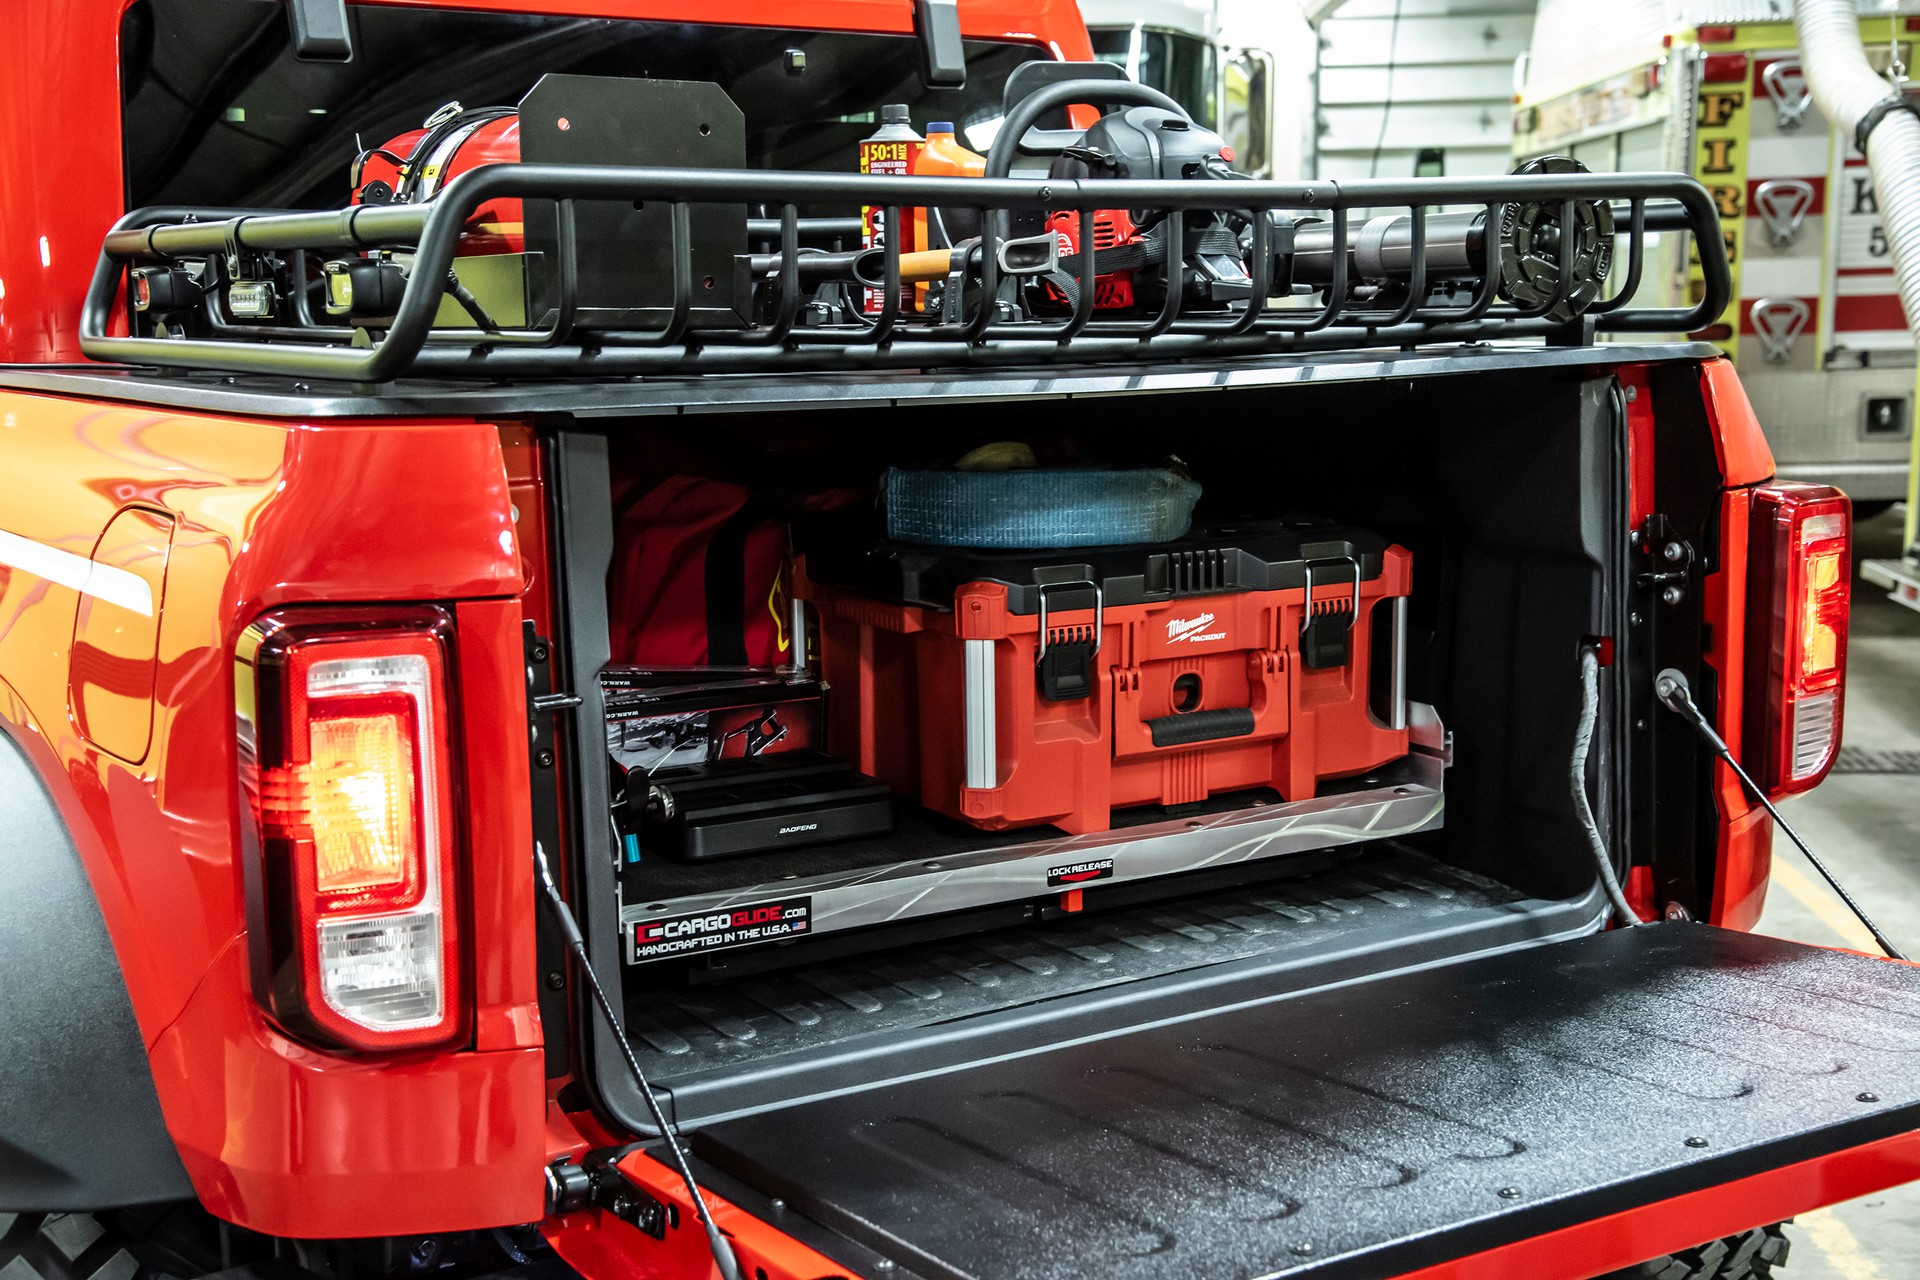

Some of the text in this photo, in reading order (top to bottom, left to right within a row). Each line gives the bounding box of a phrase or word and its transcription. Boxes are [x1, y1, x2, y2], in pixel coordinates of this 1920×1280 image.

[870, 144, 897, 161] 50:1
[898, 143, 907, 160] MIX
[1165, 612, 1215, 638] Milwaukee
[1190, 632, 1227, 642] PACKOUT
[779, 823, 818, 834] BAOFENG
[1048, 860, 1113, 877] LOCK RELEASE
[636, 923, 792, 957] HANDCRAFTED IN THE U.S.A.
